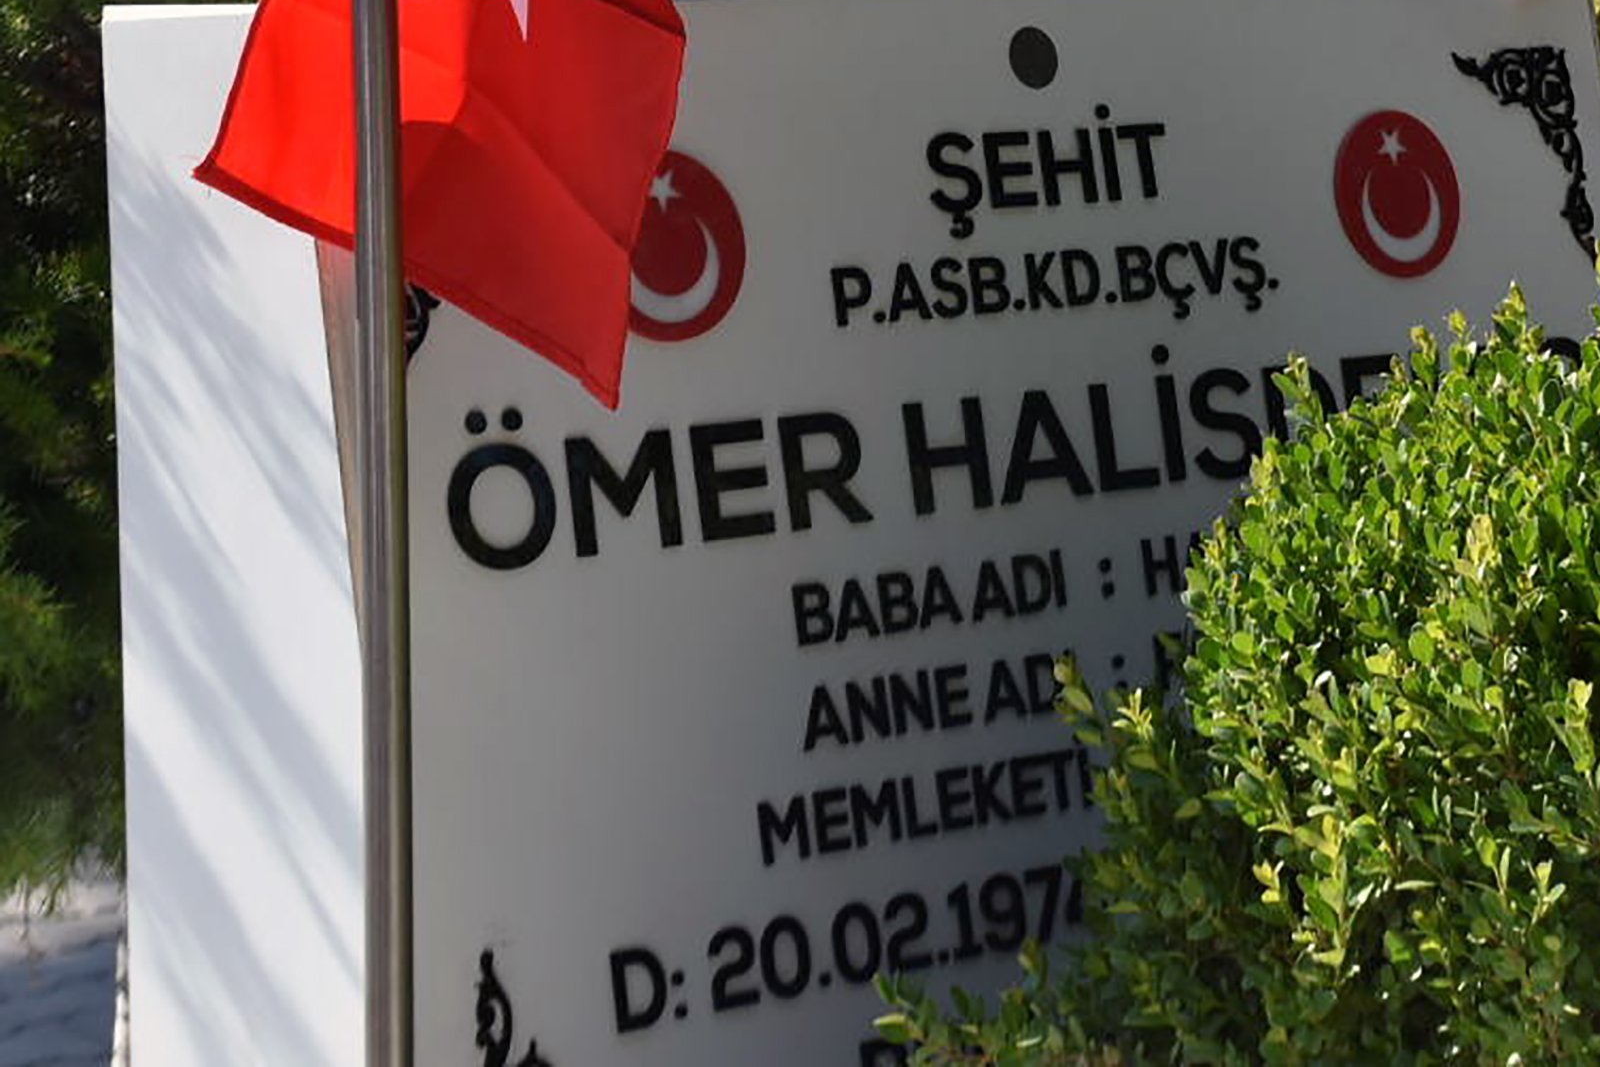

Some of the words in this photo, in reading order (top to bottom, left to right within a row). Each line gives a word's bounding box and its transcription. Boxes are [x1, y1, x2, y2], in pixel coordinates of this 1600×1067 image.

[926, 104, 1165, 239] ŞEHİT
[829, 236, 1279, 327] P.ASB.KD.BÇVŞ.
[446, 405, 873, 571] ÖMER
[803, 663, 973, 752] ANNE
